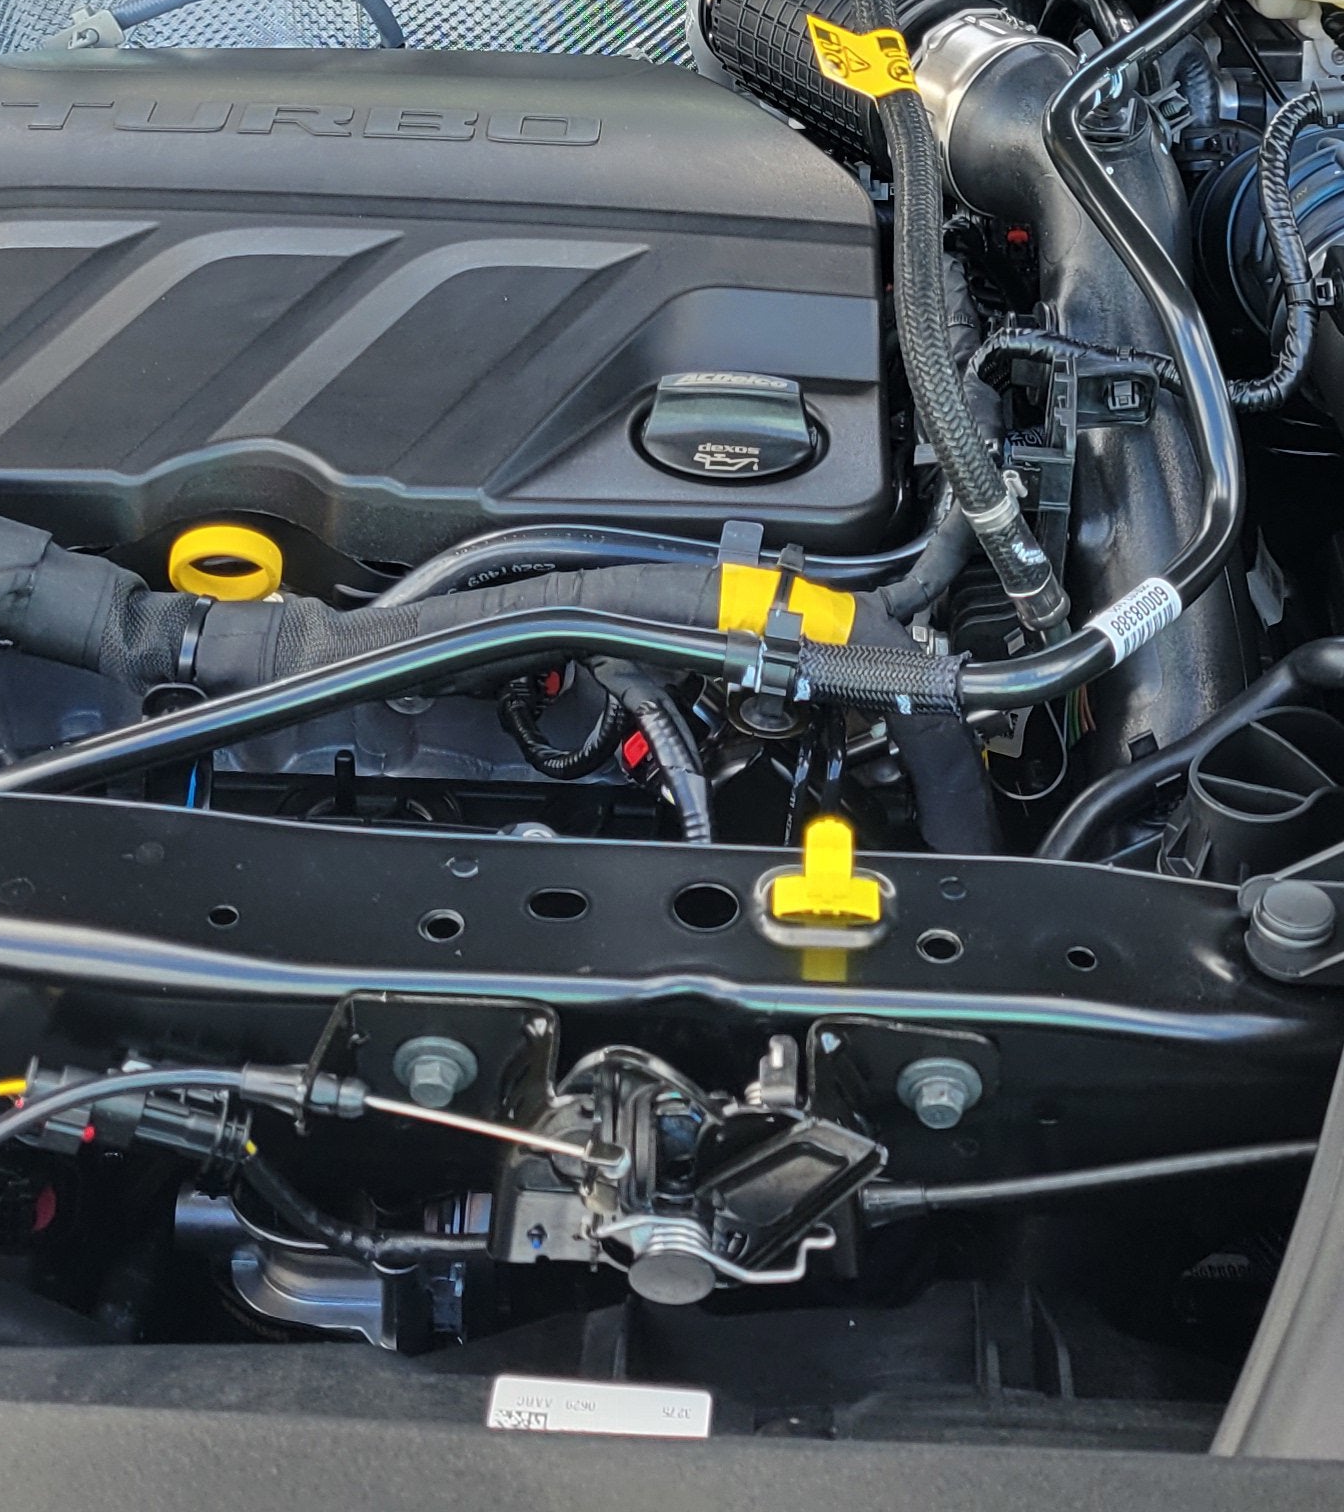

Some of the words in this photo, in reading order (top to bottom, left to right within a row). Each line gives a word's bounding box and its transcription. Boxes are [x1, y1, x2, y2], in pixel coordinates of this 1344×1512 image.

[1, 100, 603, 147] TURBO
[674, 373, 788, 388] ACDelco
[697, 443, 761, 455] dexos
[1110, 586, 1169, 637] 60008388
